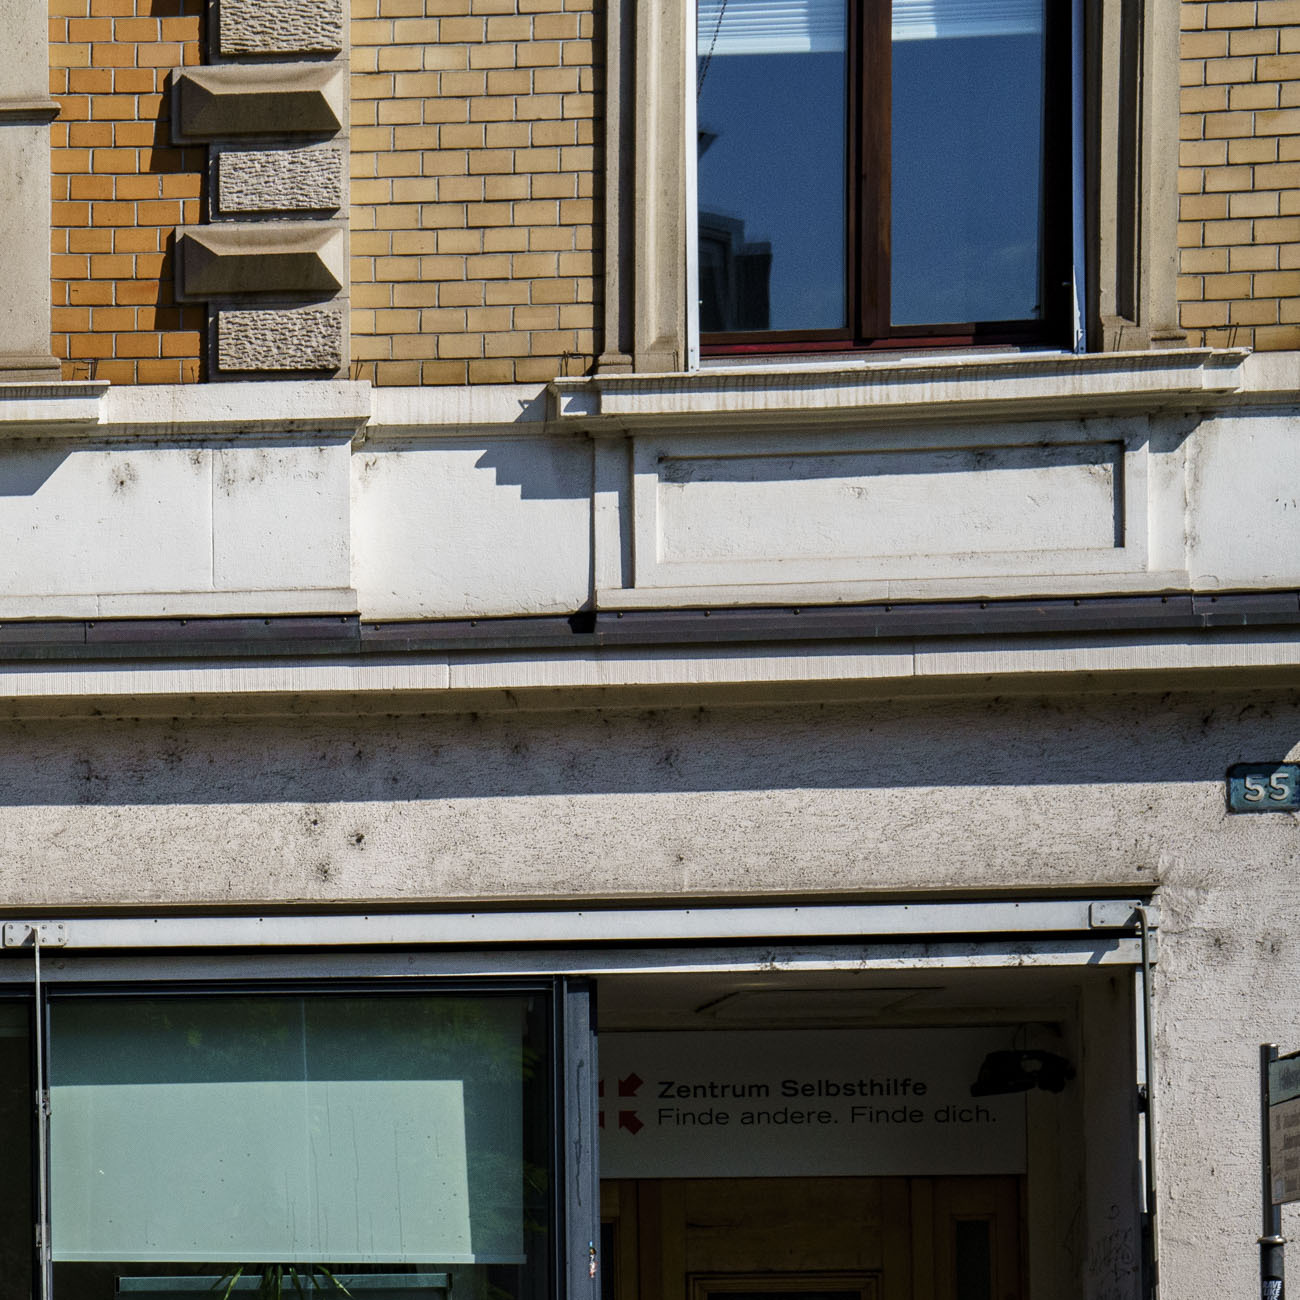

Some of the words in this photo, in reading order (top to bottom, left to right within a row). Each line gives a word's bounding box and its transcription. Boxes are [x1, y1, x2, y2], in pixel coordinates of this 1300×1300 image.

[1243, 772, 1291, 802] 55
[657, 1080, 770, 1099] Zentrum
[781, 1078, 928, 1098] Selbsthilfe
[657, 1107, 729, 1126] Finde
[740, 1106, 839, 1126] andere.
[851, 1105, 924, 1124] Finde
[934, 1104, 997, 1124] dich.
